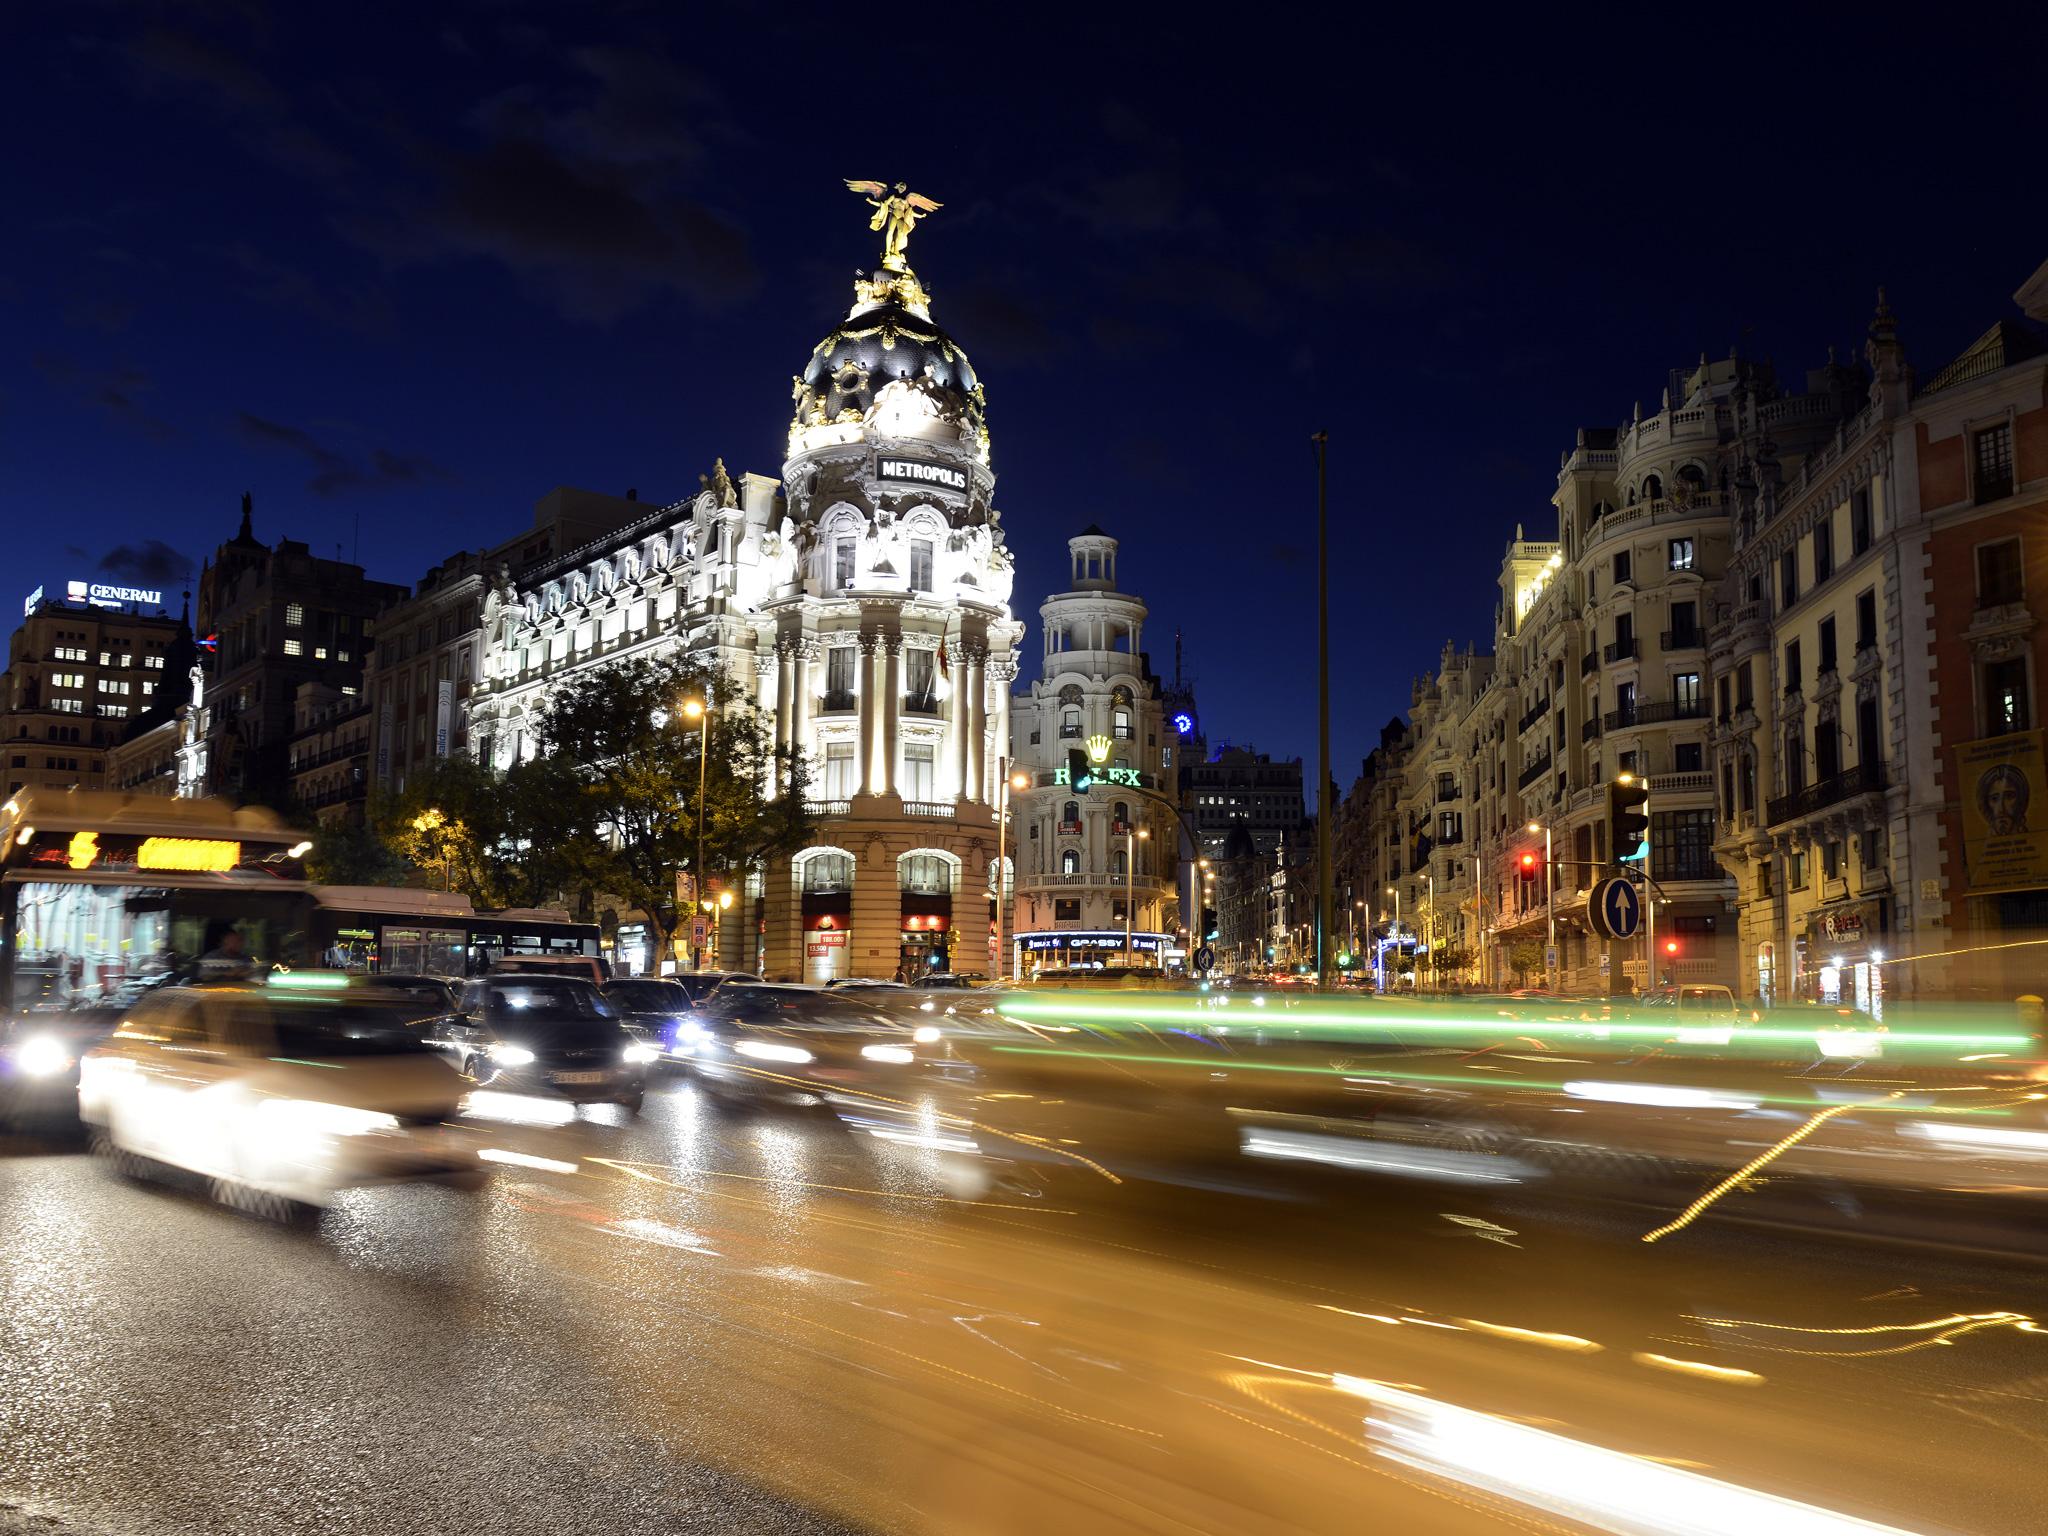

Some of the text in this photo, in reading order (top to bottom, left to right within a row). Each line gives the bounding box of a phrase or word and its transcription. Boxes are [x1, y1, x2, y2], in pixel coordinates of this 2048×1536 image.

[882, 461, 966, 489] METROPOLIS
[89, 584, 162, 604] GENERALI
[1053, 767, 1142, 787] RLEX
[1070, 939, 1123, 948] GRASSY
